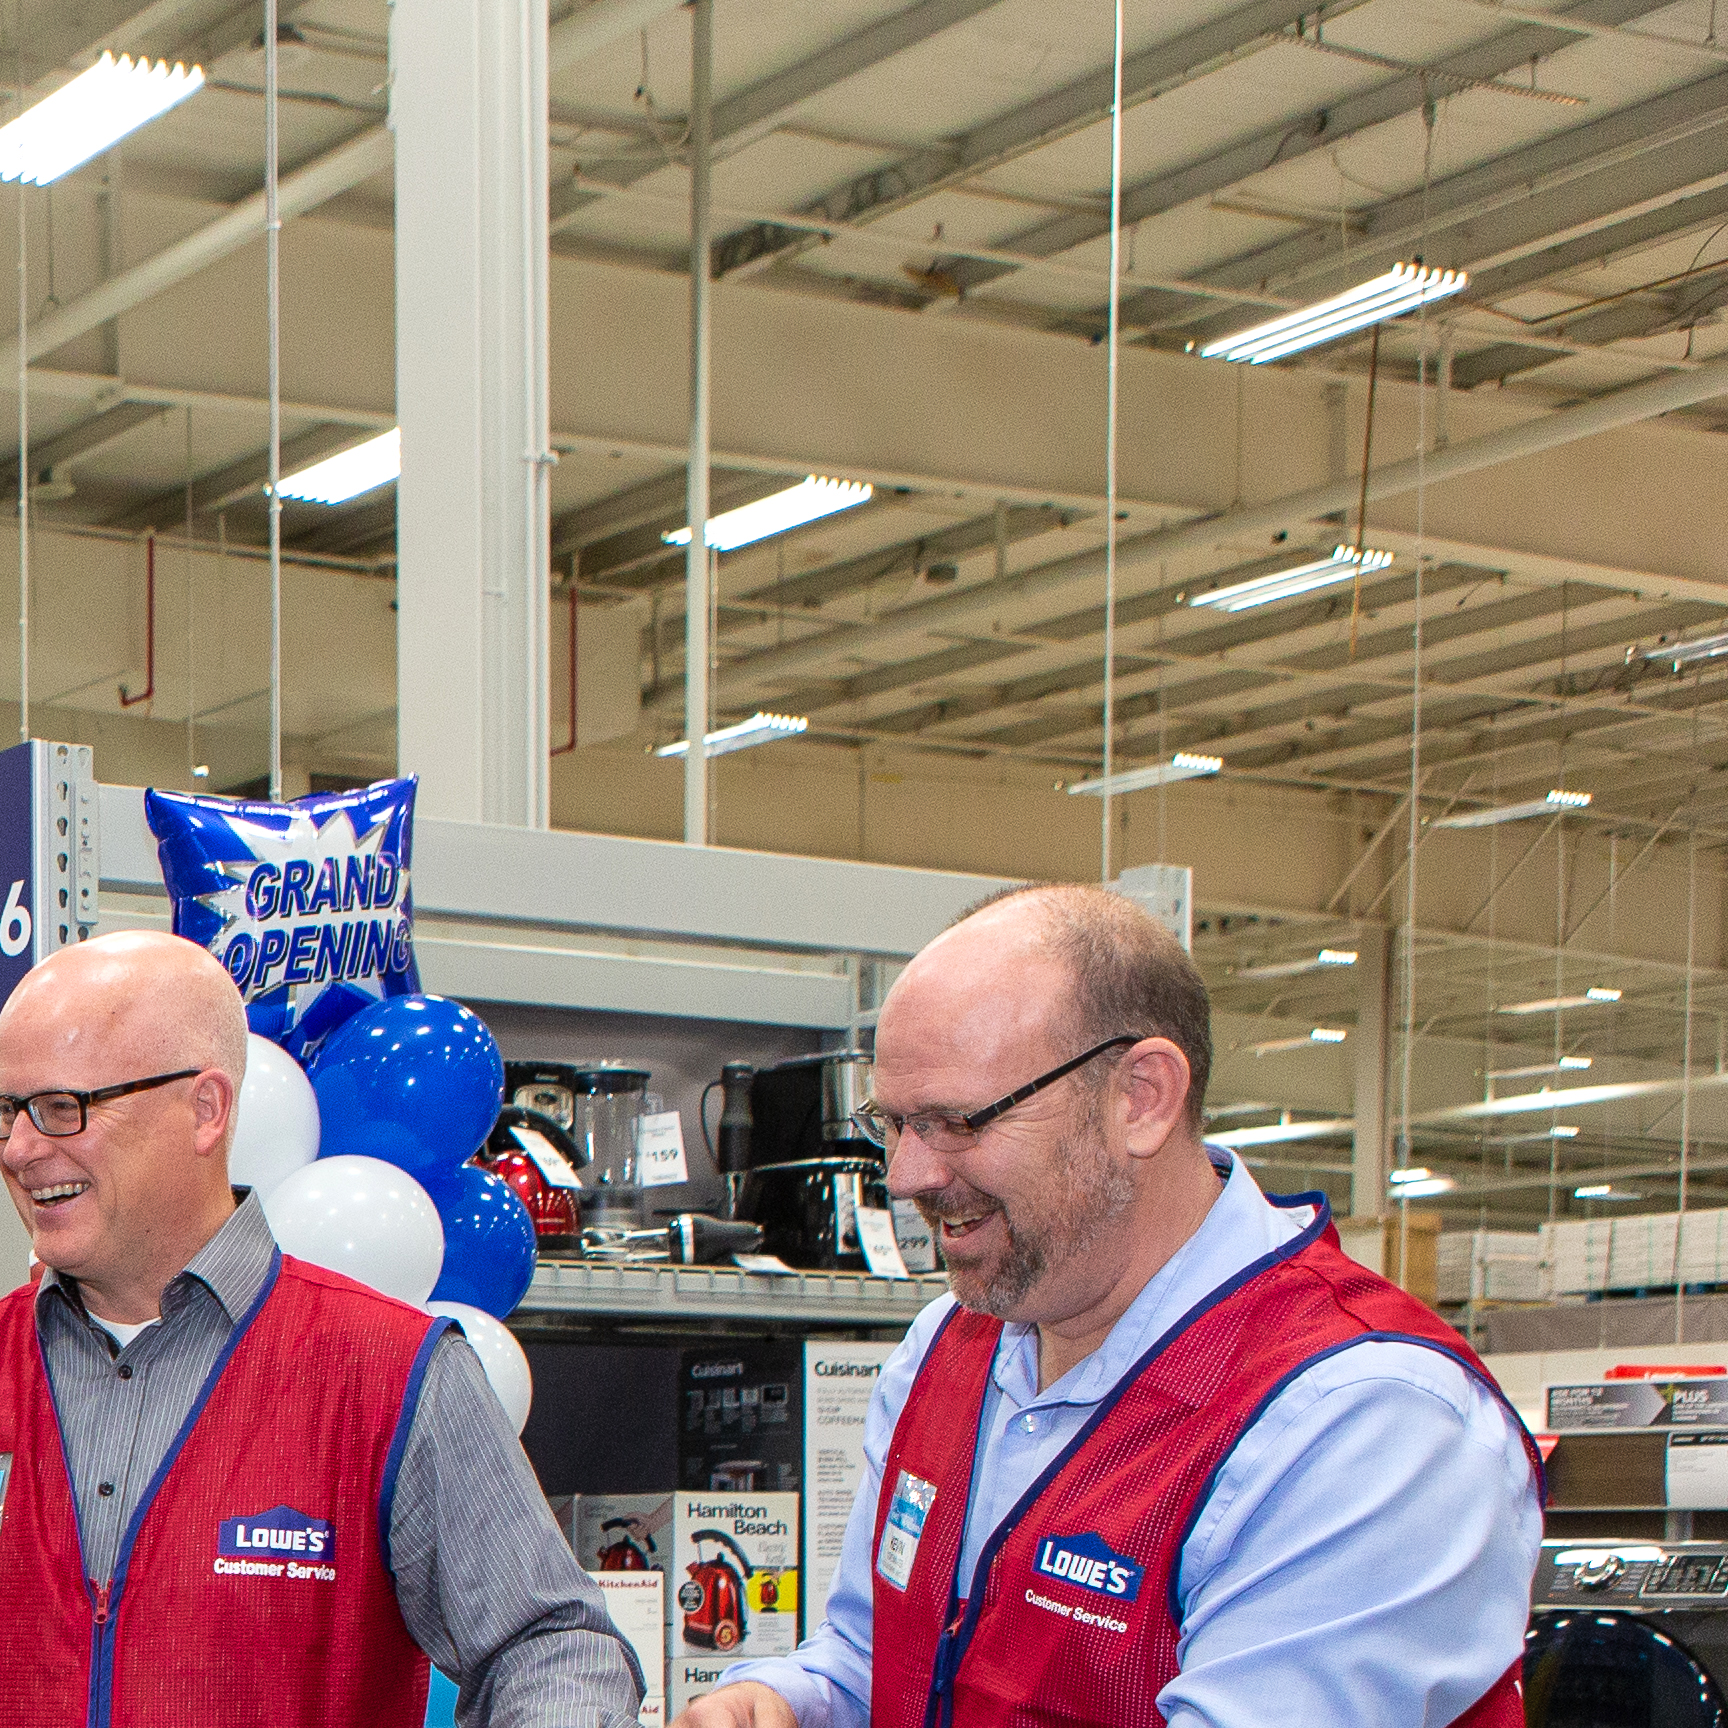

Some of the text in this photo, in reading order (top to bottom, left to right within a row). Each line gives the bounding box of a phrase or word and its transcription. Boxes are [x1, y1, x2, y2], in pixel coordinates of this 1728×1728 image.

[245, 851, 399, 922] GRAND
[222, 919, 411, 989] OPENING
[692, 1362, 744, 1378] Cuisinart
[815, 1360, 881, 1377] Cuisinart
[1673, 1389, 1709, 1403] PLUS
[687, 1503, 767, 1518] Hamilton
[734, 1519, 787, 1535] Beach
[235, 1524, 324, 1552] LOWE'S
[214, 1558, 335, 1580] Customer Service
[1040, 1541, 1130, 1594] LOWE'S
[598, 1580, 659, 1588] KitchenAid
[1025, 1589, 1128, 1632] Customer Service
